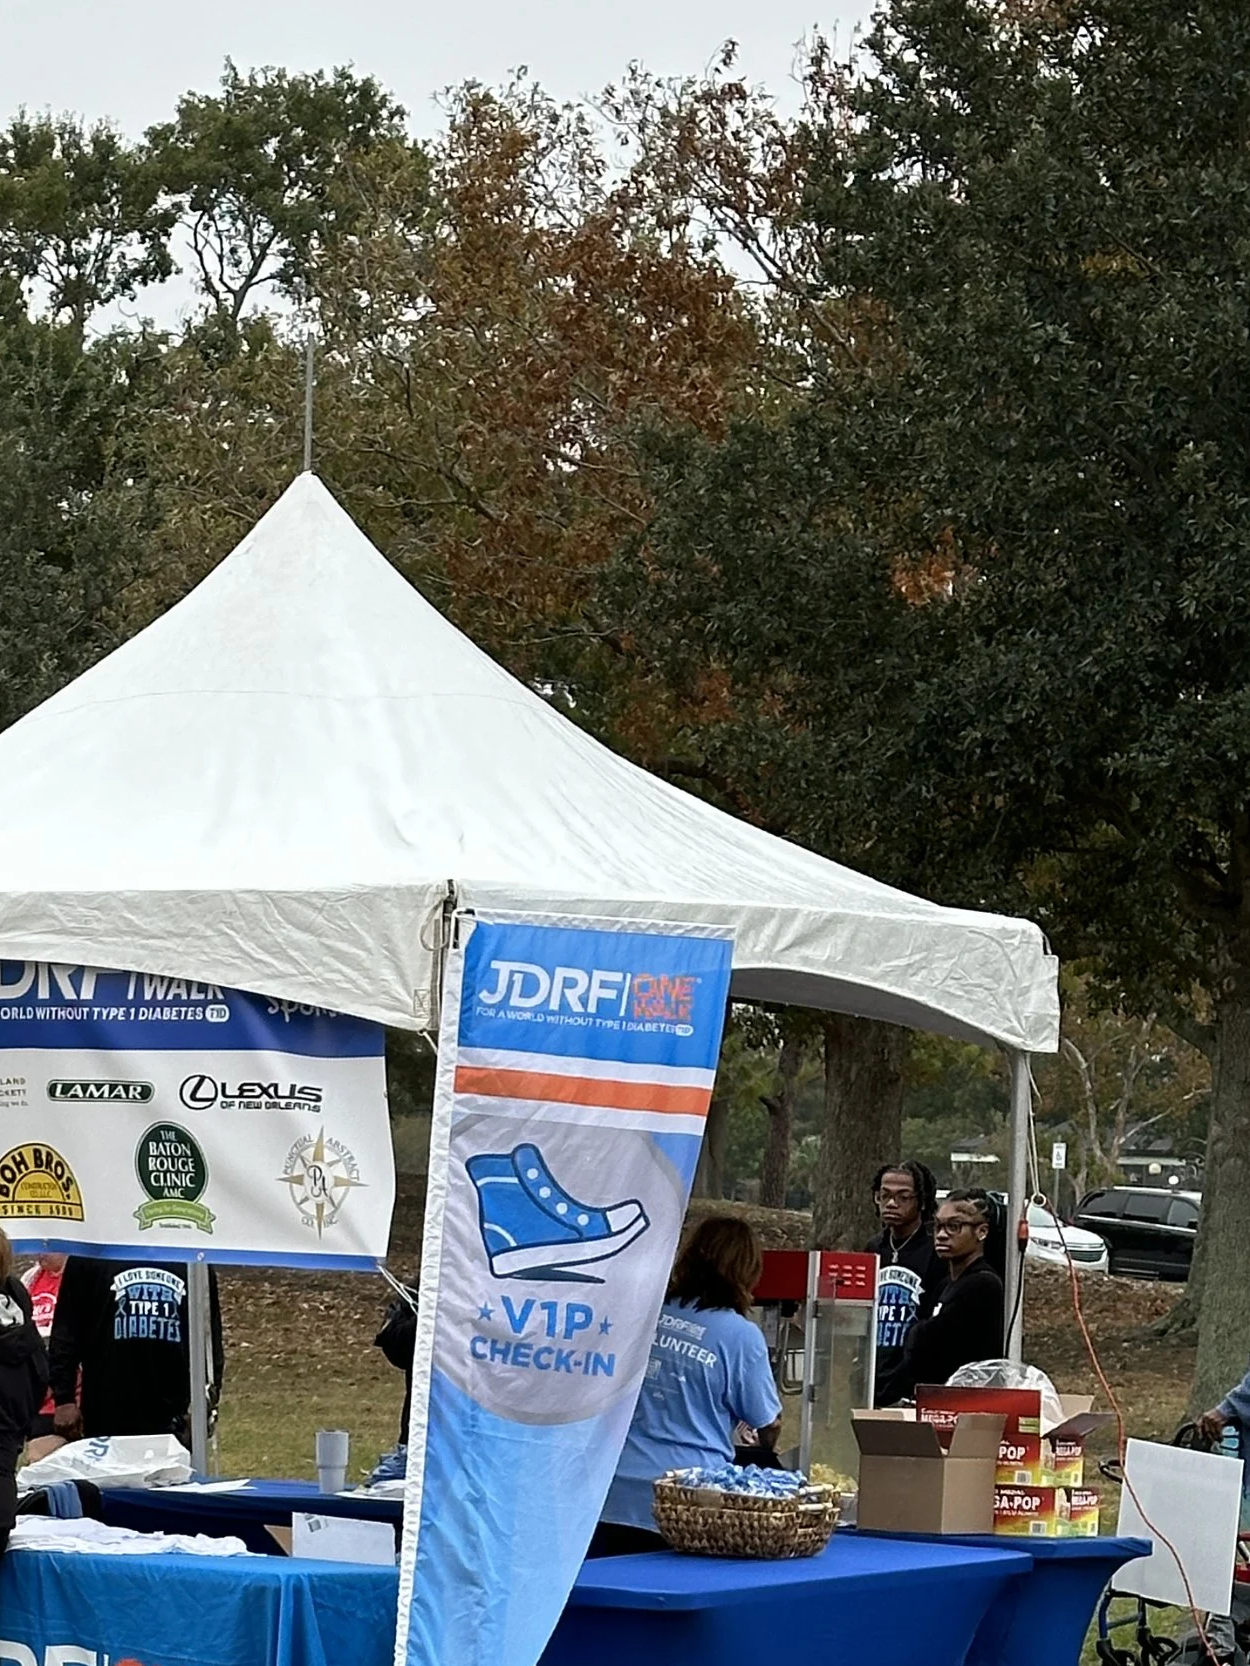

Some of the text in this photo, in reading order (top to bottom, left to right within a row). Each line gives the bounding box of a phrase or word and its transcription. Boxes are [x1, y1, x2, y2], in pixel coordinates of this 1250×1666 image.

[143, 974, 225, 1000] WALK
[479, 960, 624, 1014] JDRF
[35, 1007, 90, 1020] WITHOUT
[92, 1007, 128, 1020] TYPE
[129, 1007, 136, 1020] 1
[138, 1007, 204, 1020] DIABETES
[476, 1006, 496, 1018] FOR
[498, 1010, 507, 1019] A
[506, 1011, 545, 1023] WORLD
[546, 1015, 593, 1027] WITHOUT
[595, 1019, 620, 1031] TYPE
[54, 1083, 144, 1100] LAMAR
[220, 1082, 323, 1103] LEXUS
[220, 1101, 321, 1114] OF NEW ORLEANS
[160, 1130, 178, 1141] THE
[148, 1141, 192, 1157] BATON
[148, 1157, 196, 1172] ROUGE
[150, 1172, 196, 1188] CLINIC
[123, 1270, 143, 1282] LOVE
[127, 1283, 173, 1301] WITH
[129, 1301, 169, 1317] TYPE 1
[501, 1295, 594, 1340] V1P
[114, 1315, 182, 1342] DIABETES
[470, 1335, 615, 1377] CHECK-IN
[651, 1335, 717, 1368] UNTEER
